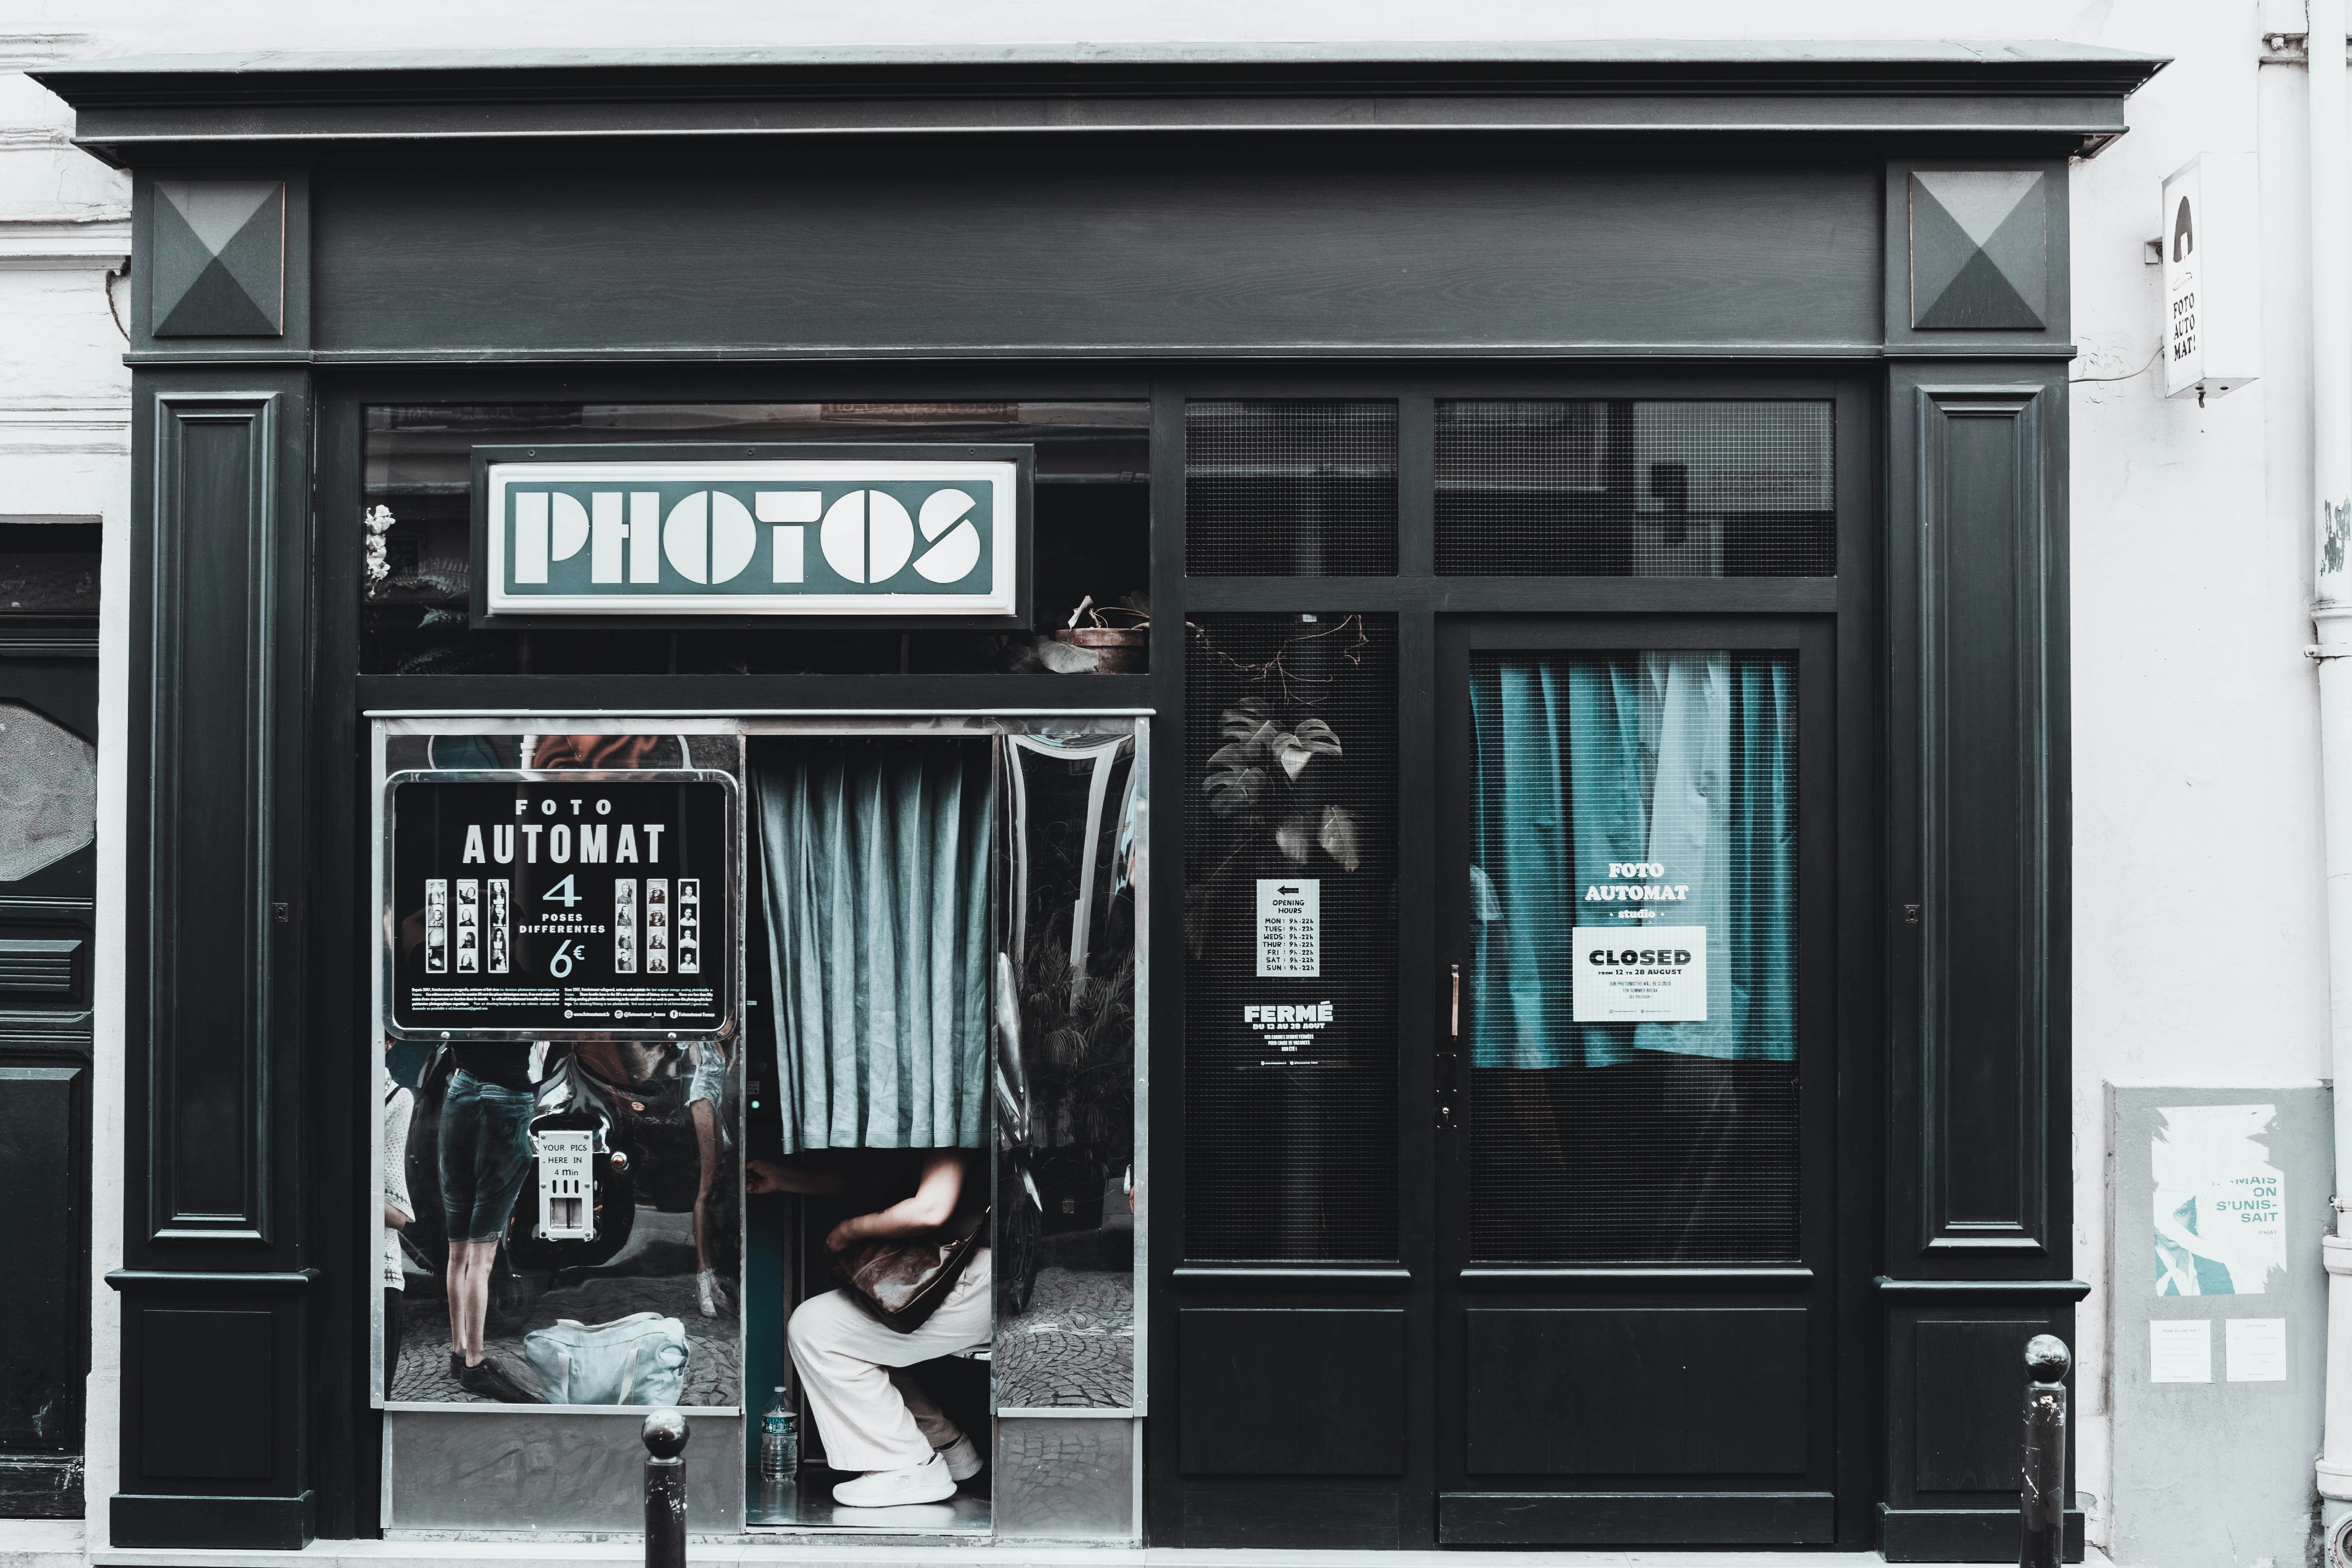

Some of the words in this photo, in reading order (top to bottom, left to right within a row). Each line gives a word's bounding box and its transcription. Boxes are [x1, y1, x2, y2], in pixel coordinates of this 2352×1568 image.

[2174, 292, 2194, 319] FOTO
[2174, 314, 2194, 340] AUTO
[2174, 334, 2195, 361] MAT!
[515, 488, 981, 585] PHOTOS
[516, 799, 611, 815] FOTO
[462, 824, 664, 863] AUTOMAT
[1609, 863, 1664, 877] FOTO
[542, 874, 582, 907] 4
[1585, 885, 1689, 900] AUTOMAT
[1618, 909, 1655, 918] studio
[519, 925, 605, 933] DIFFERENTES
[550, 940, 585, 978] 6€
[1589, 950, 1691, 966] CLOSED
[1245, 1000, 1333, 1022] FERMÉ
[2253, 1187, 2276, 1196] ON
[2216, 1200, 2277, 1211] S'UNIS-
[2241, 1212, 2278, 1222] SAIT
